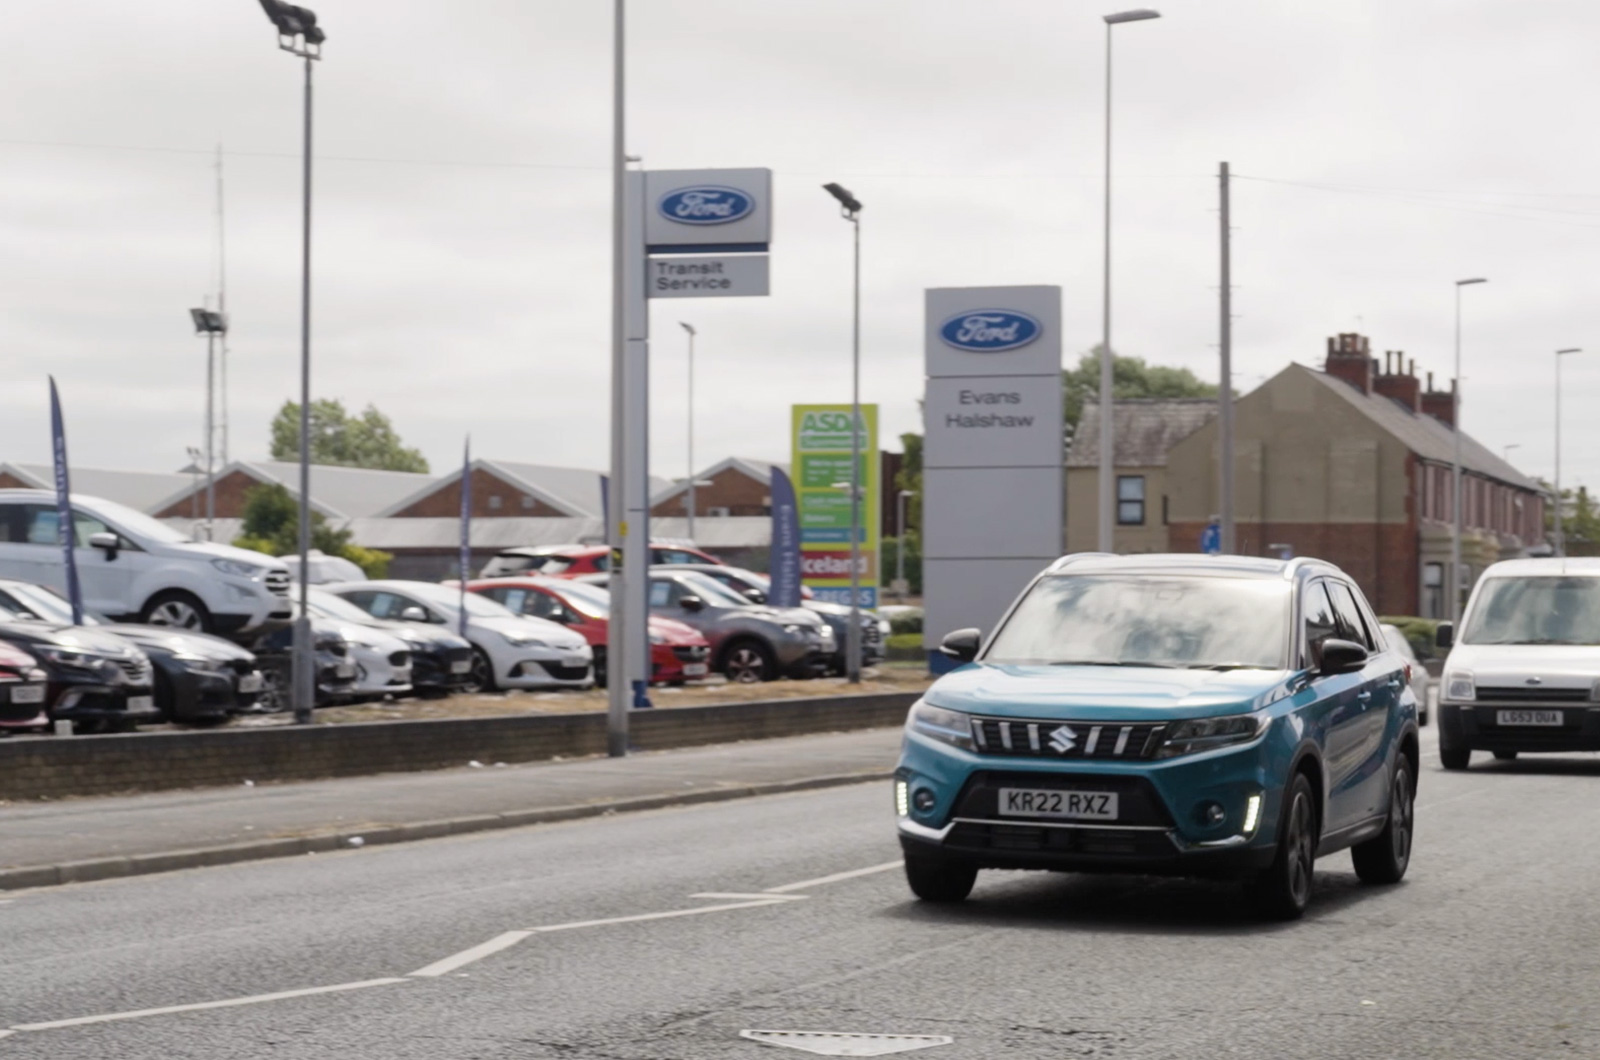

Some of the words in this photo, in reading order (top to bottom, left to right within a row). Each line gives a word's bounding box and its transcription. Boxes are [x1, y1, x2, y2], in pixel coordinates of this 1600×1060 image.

[675, 191, 735, 216] Ford
[656, 261, 725, 275] Transit
[656, 277, 732, 290] Service
[956, 315, 1021, 342] Ford
[958, 389, 1021, 405] Evans
[945, 413, 1035, 428] Halshaw
[1007, 791, 1062, 812] KR22
[1068, 794, 1110, 814] RXZ
